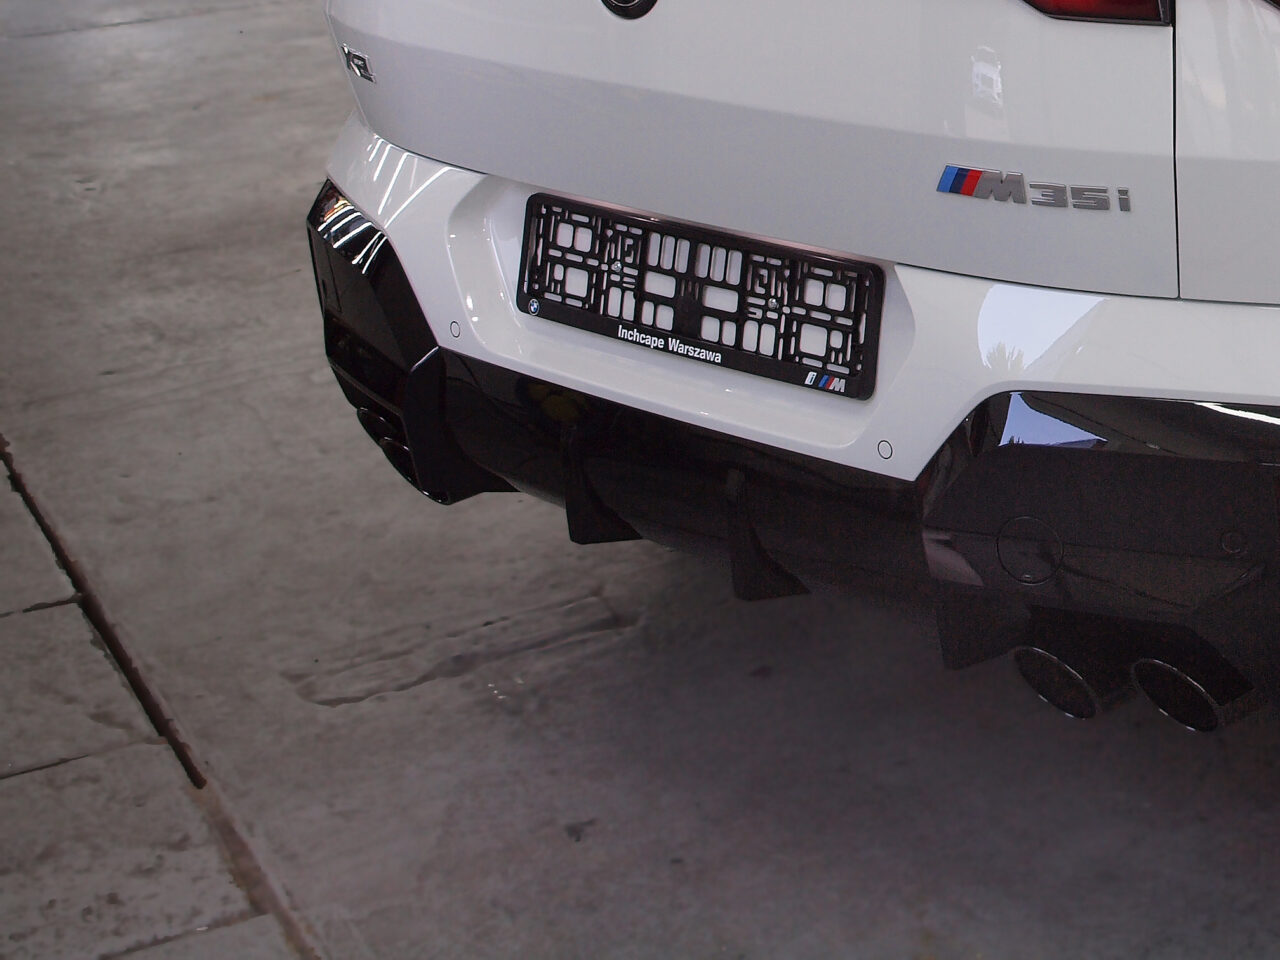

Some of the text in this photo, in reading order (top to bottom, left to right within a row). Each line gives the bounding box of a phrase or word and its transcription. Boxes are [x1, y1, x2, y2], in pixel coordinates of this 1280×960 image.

[973, 169, 1132, 212] M35i
[617, 324, 722, 364] Inchcape Warszawa
